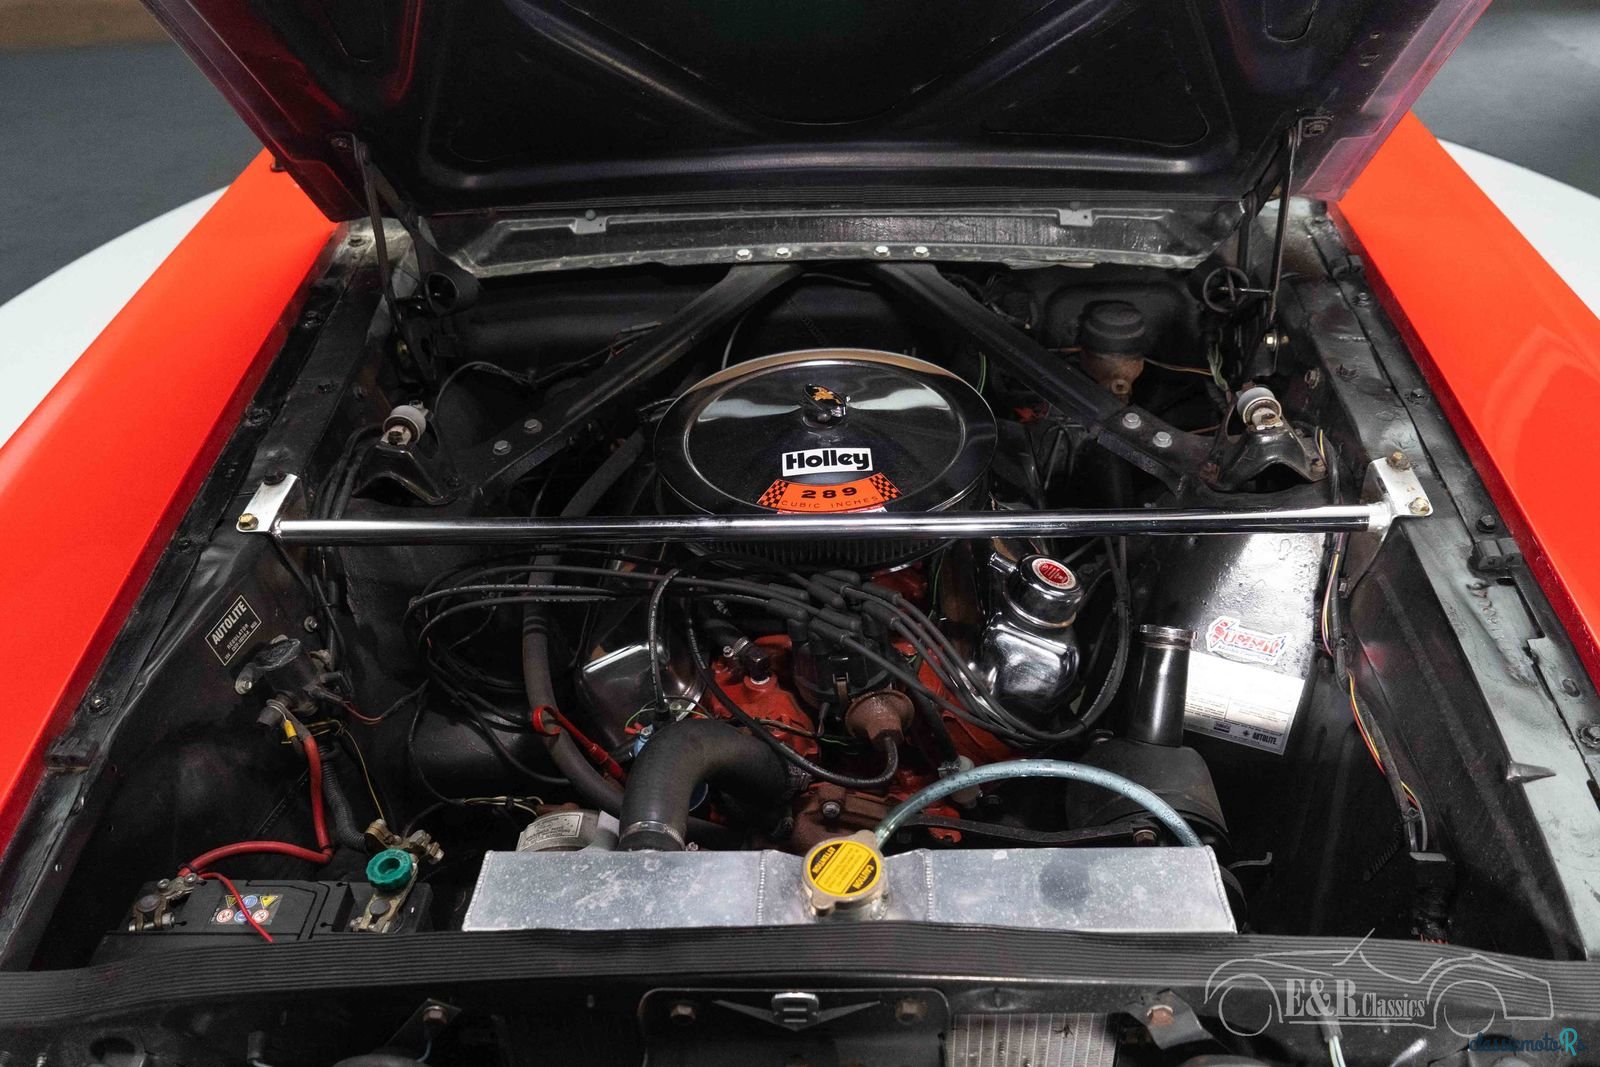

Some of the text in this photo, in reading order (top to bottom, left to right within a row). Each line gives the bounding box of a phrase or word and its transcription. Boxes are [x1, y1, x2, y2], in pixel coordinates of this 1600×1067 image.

[786, 450, 869, 471] Holley
[801, 487, 857, 499] 289
[781, 496, 878, 509] CUBIC INCHES
[211, 601, 247, 645] AUTOLITE
